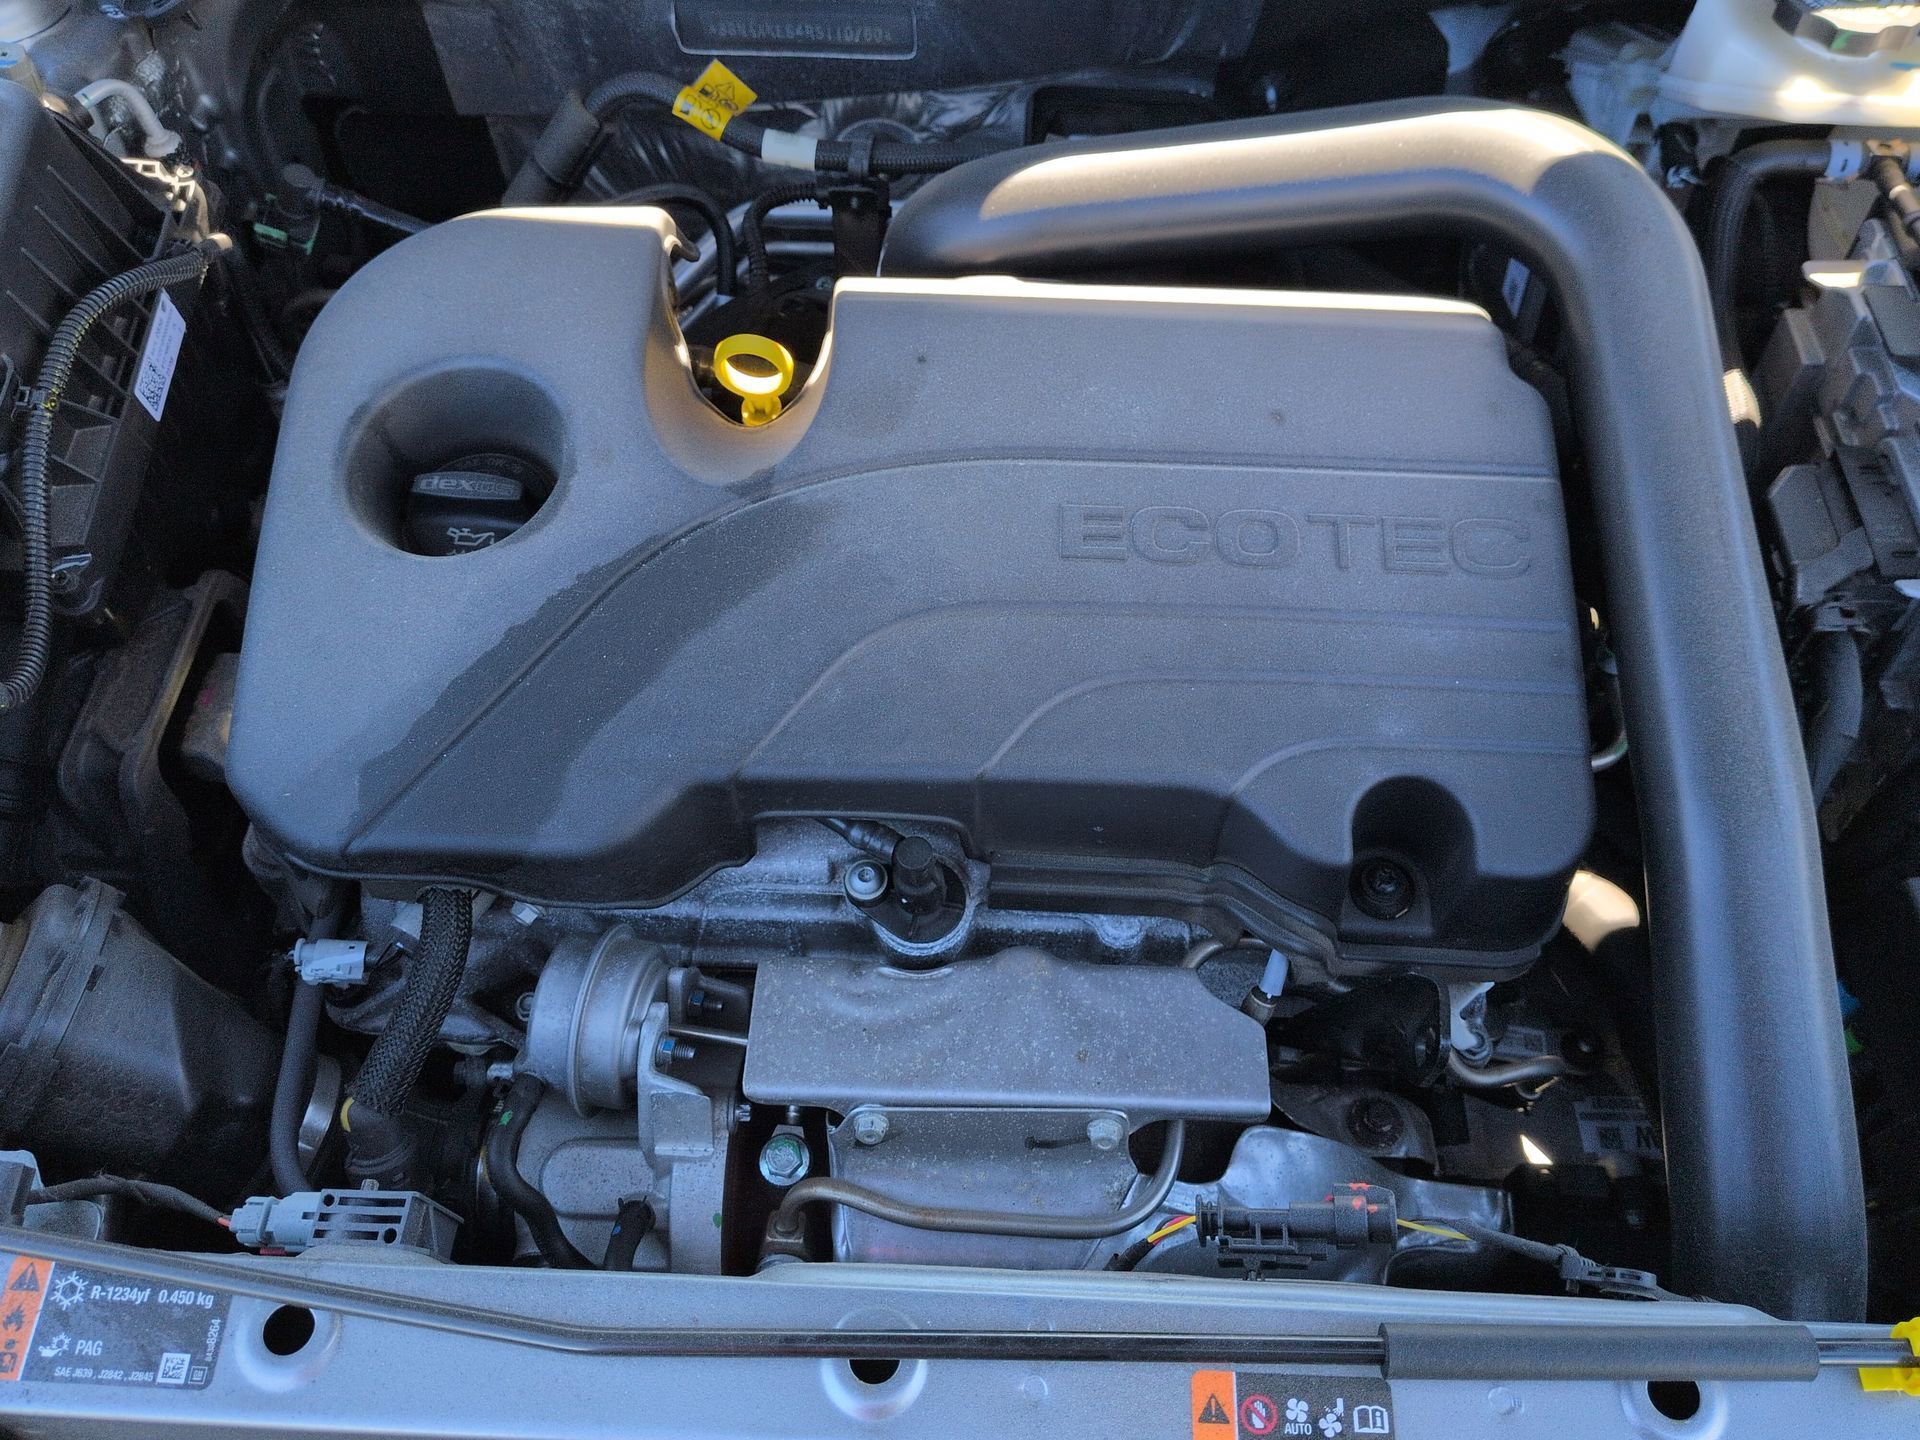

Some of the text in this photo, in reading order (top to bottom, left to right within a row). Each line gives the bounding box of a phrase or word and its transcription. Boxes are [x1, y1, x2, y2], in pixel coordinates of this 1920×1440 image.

[1060, 504, 1532, 578] ECOTEC
[90, 1285, 214, 1309] R-1234yf 0.450 kg
[75, 1340, 103, 1356] PAG
[54, 1366, 72, 1377] SAE
[1285, 1423, 1312, 1435] AUTO
